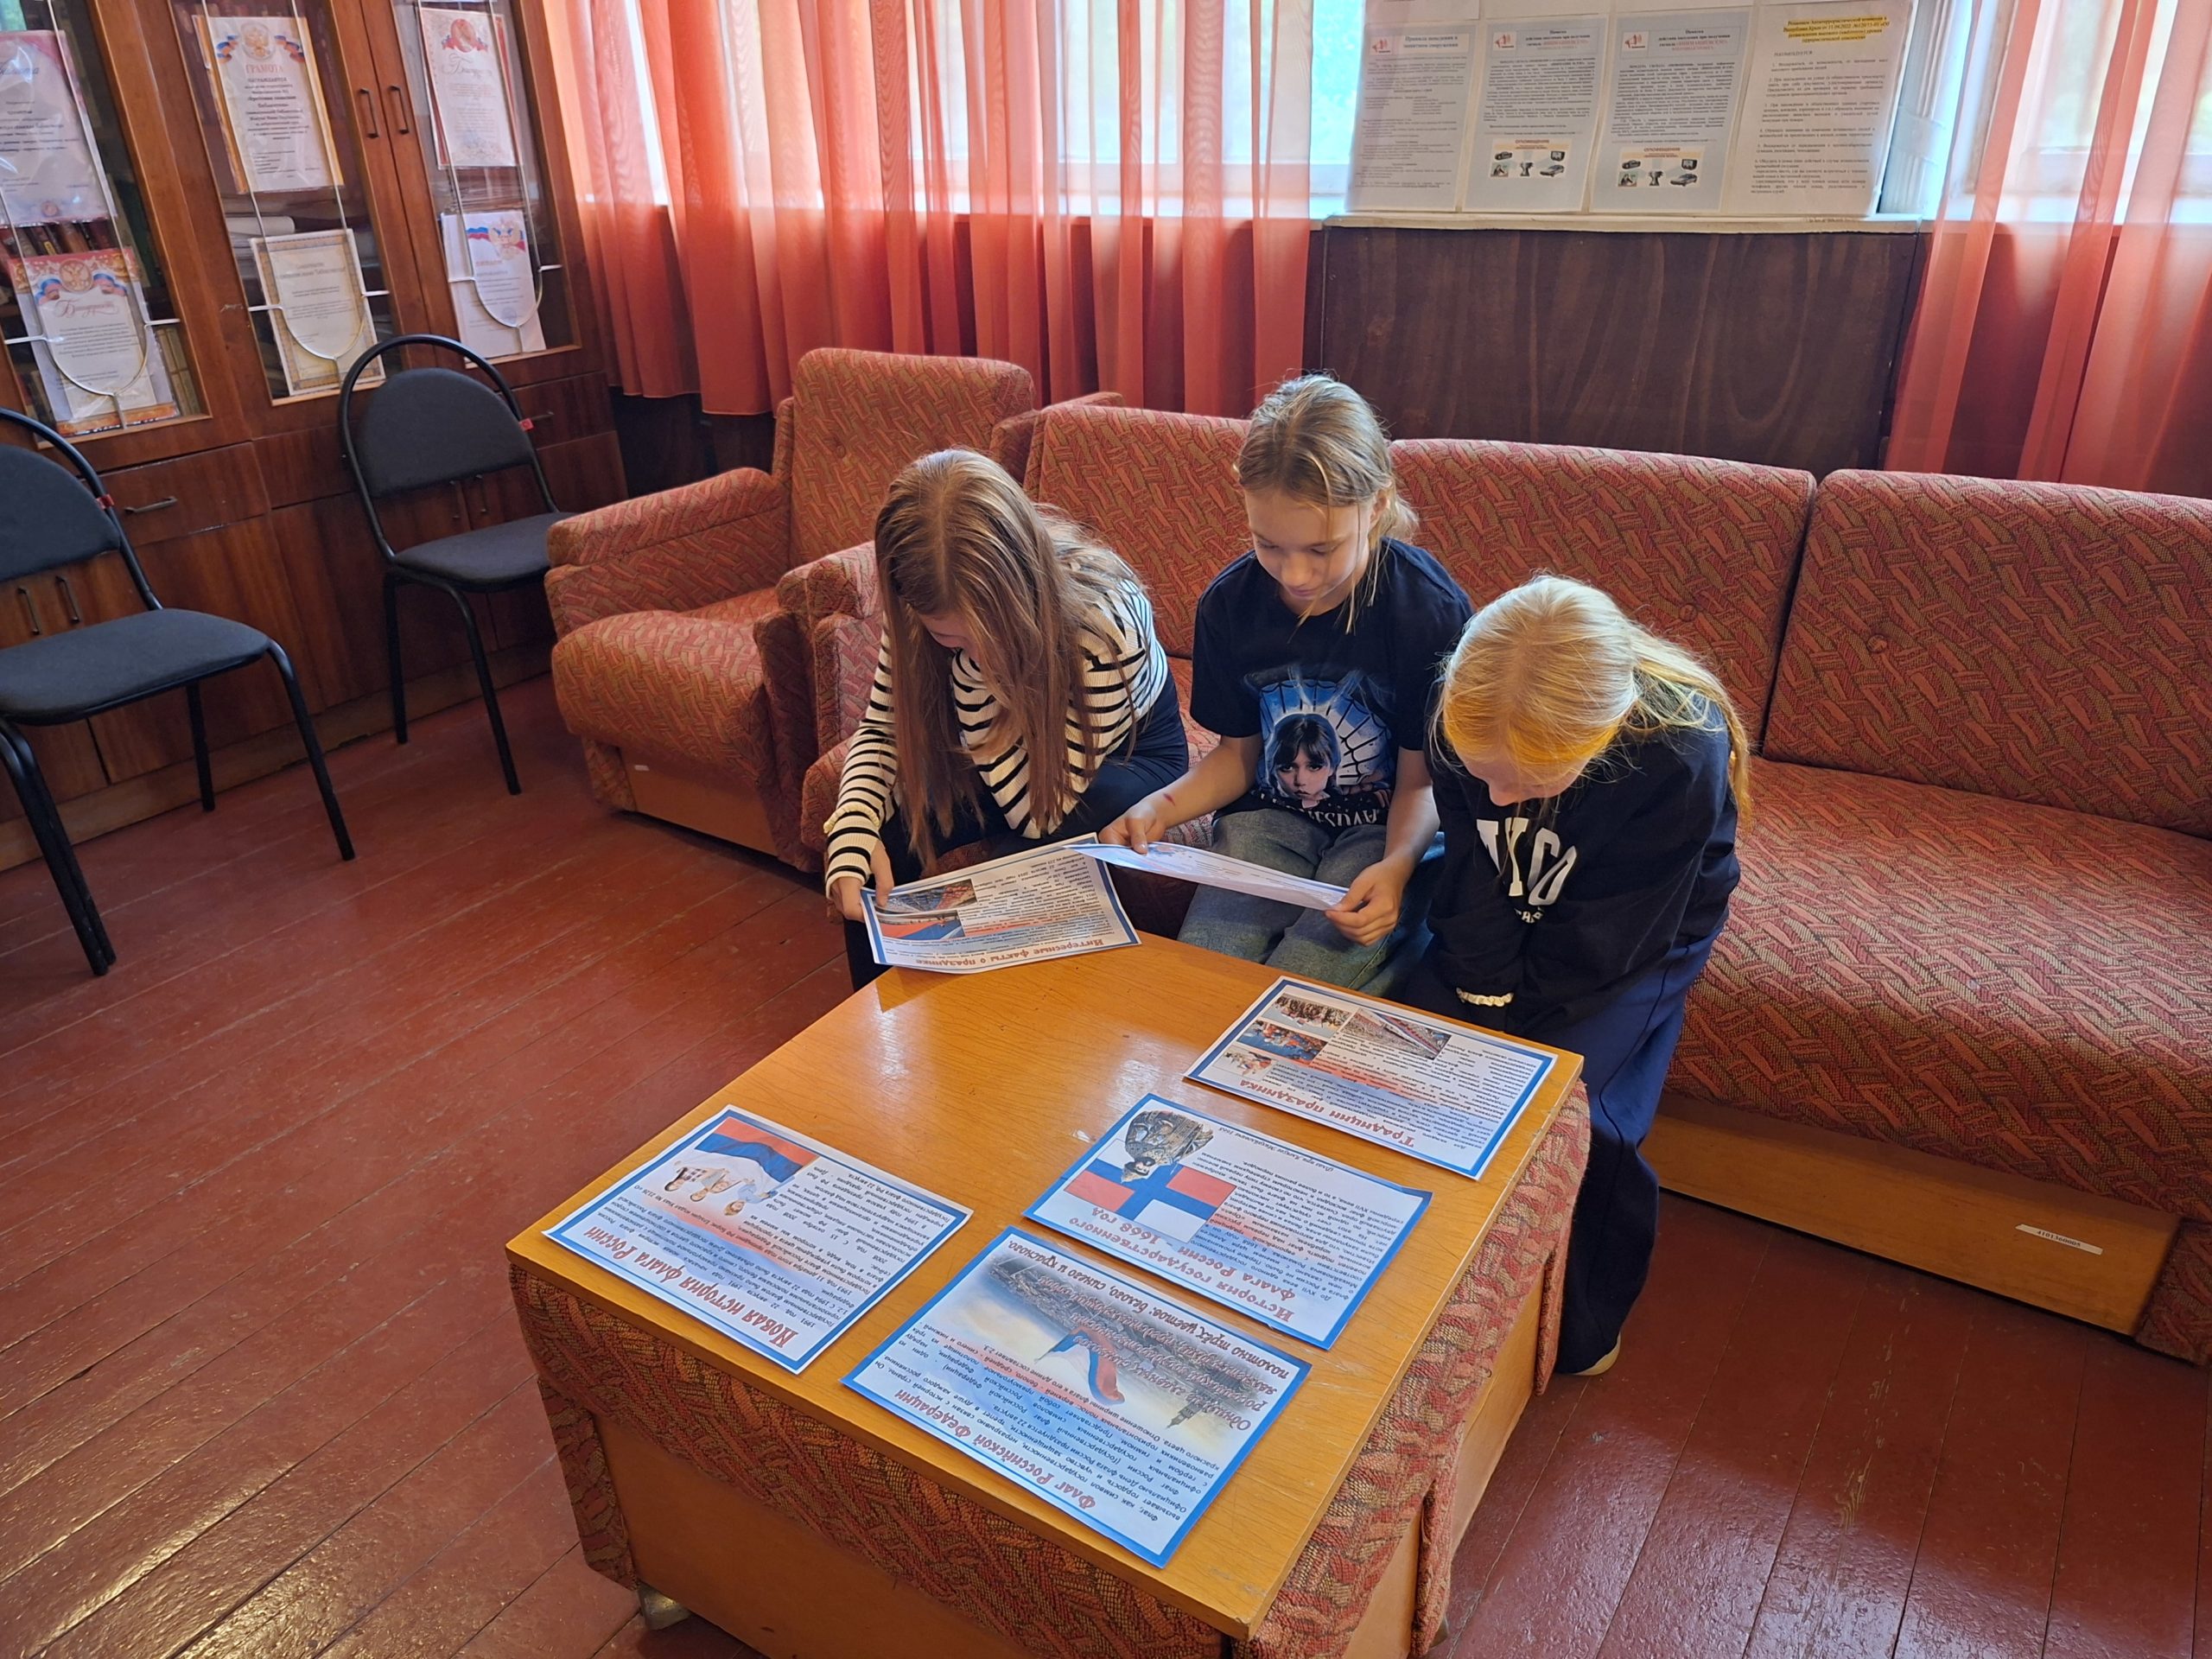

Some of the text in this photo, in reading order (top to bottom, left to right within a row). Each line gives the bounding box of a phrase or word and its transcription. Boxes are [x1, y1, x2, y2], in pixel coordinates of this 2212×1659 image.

[989, 948, 1030, 963] факты
[1033, 938, 1105, 955] Интересные
[1239, 1078, 1415, 1148] Традиции праздника
[1090, 1204, 1122, 1225] год
[1118, 1222, 1166, 1245] 1668
[1007, 1239, 1059, 1269] красного.
[1176, 1242, 1238, 1278] России
[1066, 1268, 1108, 1291] синего
[1068, 1217, 1296, 1324] История государственного
[582, 1225, 800, 1349] Новая история флага России
[1242, 1271, 1296, 1302] флага
[1108, 1284, 1149, 1313] белого,
[1147, 1306, 1199, 1335] цветов:
[912, 1326, 927, 1338] трёх
[1194, 1325, 1232, 1351] трёх
[911, 1346, 930, 1359] один
[942, 1343, 981, 1366] полотнище
[982, 1344, 996, 1355] 2:3.
[883, 1354, 923, 1378] россиянина.
[994, 1351, 1031, 1373] составляет
[1230, 1345, 1290, 1379] полотно
[887, 1366, 912, 1384] страны.
[922, 1376, 952, 1395] каждого
[941, 1363, 983, 1389] Федерации)
[982, 1364, 1036, 1396] прямоугольное
[1028, 1369, 1053, 1384] длине
[1050, 1380, 1065, 1391] его
[911, 1382, 944, 1402] историей
[952, 1394, 976, 1407] душе
[987, 1389, 1029, 1414] Российской
[1038, 1394, 1062, 1410] собой
[1065, 1389, 1090, 1405] флага
[904, 1332, 1203, 1495] официальных государственных символов Российской Федерации, наряду
[950, 1403, 976, 1420] связан
[982, 1407, 1006, 1427] трепет
[992, 1403, 1020, 1421] августа.
[1033, 1413, 1052, 1427] флаг
[1088, 1400, 1121, 1420] ширины
[976, 1417, 1020, 1445] неразрывно
[1064, 1409, 1115, 1440] Представляет
[1118, 1415, 1161, 1443] Отношение
[1009, 1423, 1064, 1458] защищенности,
[1026, 1423, 1071, 1451] празднуется
[1055, 1426, 1122, 1466] (Государственный
[1162, 1438, 1186, 1455] цвета.
[893, 1388, 1096, 1510] Флаг Российской Федерации
[1069, 1446, 1096, 1466] России
[1119, 1437, 1151, 1459] гимном.
[1021, 1441, 1089, 1484] государственности,
[1065, 1456, 1094, 1475] чувство
[1095, 1460, 1118, 1478] флага
[1185, 1451, 1221, 1471] красного
[1117, 1473, 1141, 1488] День
[1126, 1464, 1155, 1484] России
[1167, 1464, 1198, 1483] гербом
[1090, 1481, 1120, 1500] символ
[1106, 1478, 1141, 1500] гордость
[1137, 1484, 1188, 1514] Официально
[1160, 1482, 1180, 1496] Флаг
[1120, 1497, 1136, 1509] как
[1138, 1505, 1159, 1522] Флаг,
[1141, 1497, 1182, 1522] вызывает
